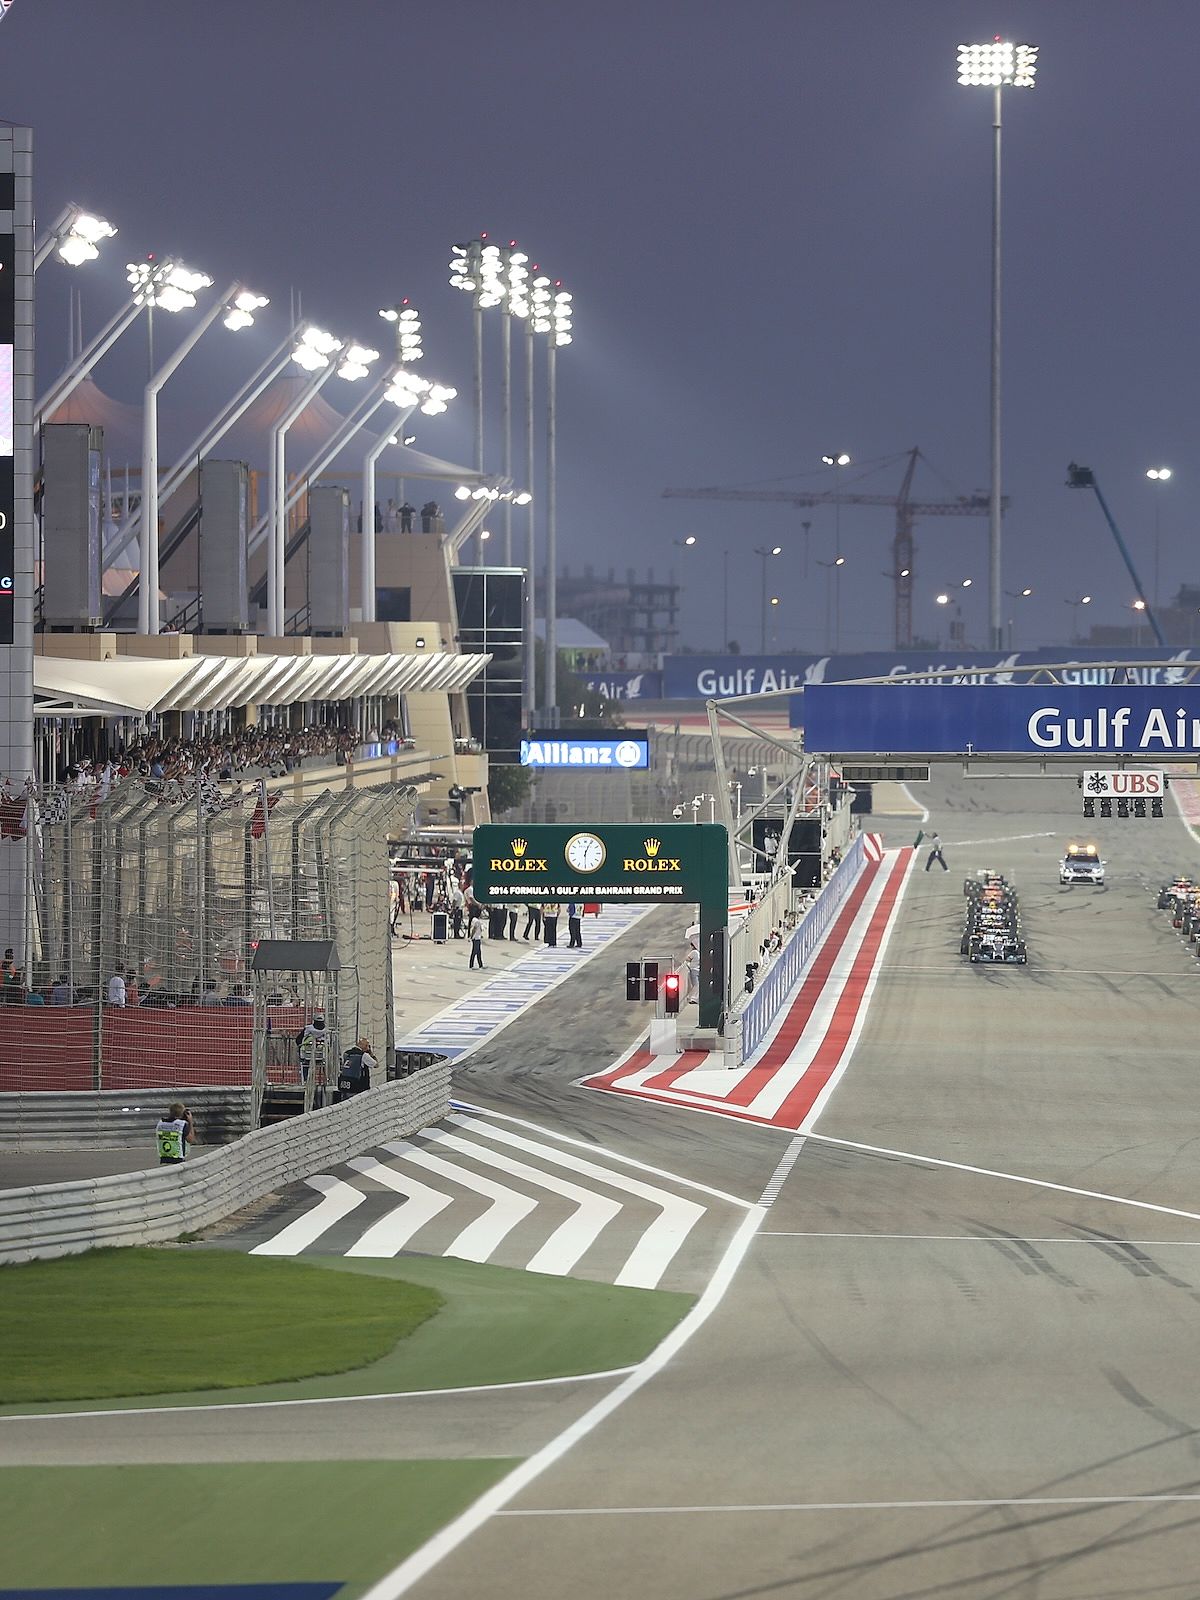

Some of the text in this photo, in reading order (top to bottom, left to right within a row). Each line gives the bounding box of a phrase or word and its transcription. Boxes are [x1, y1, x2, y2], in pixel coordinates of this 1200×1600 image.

[599, 682, 623, 699] Air
[697, 668, 800, 695] Gulf Air
[1028, 707, 1131, 748] Gulf
[528, 742, 612, 764] Allianz
[1112, 774, 1160, 794] UBS
[490, 859, 549, 872] ROLEX
[623, 859, 681, 872] ROLEX
[489, 886, 683, 895] 2014 FORMULA 1 GULF AIR BAHRAIN GRAND PRIX
